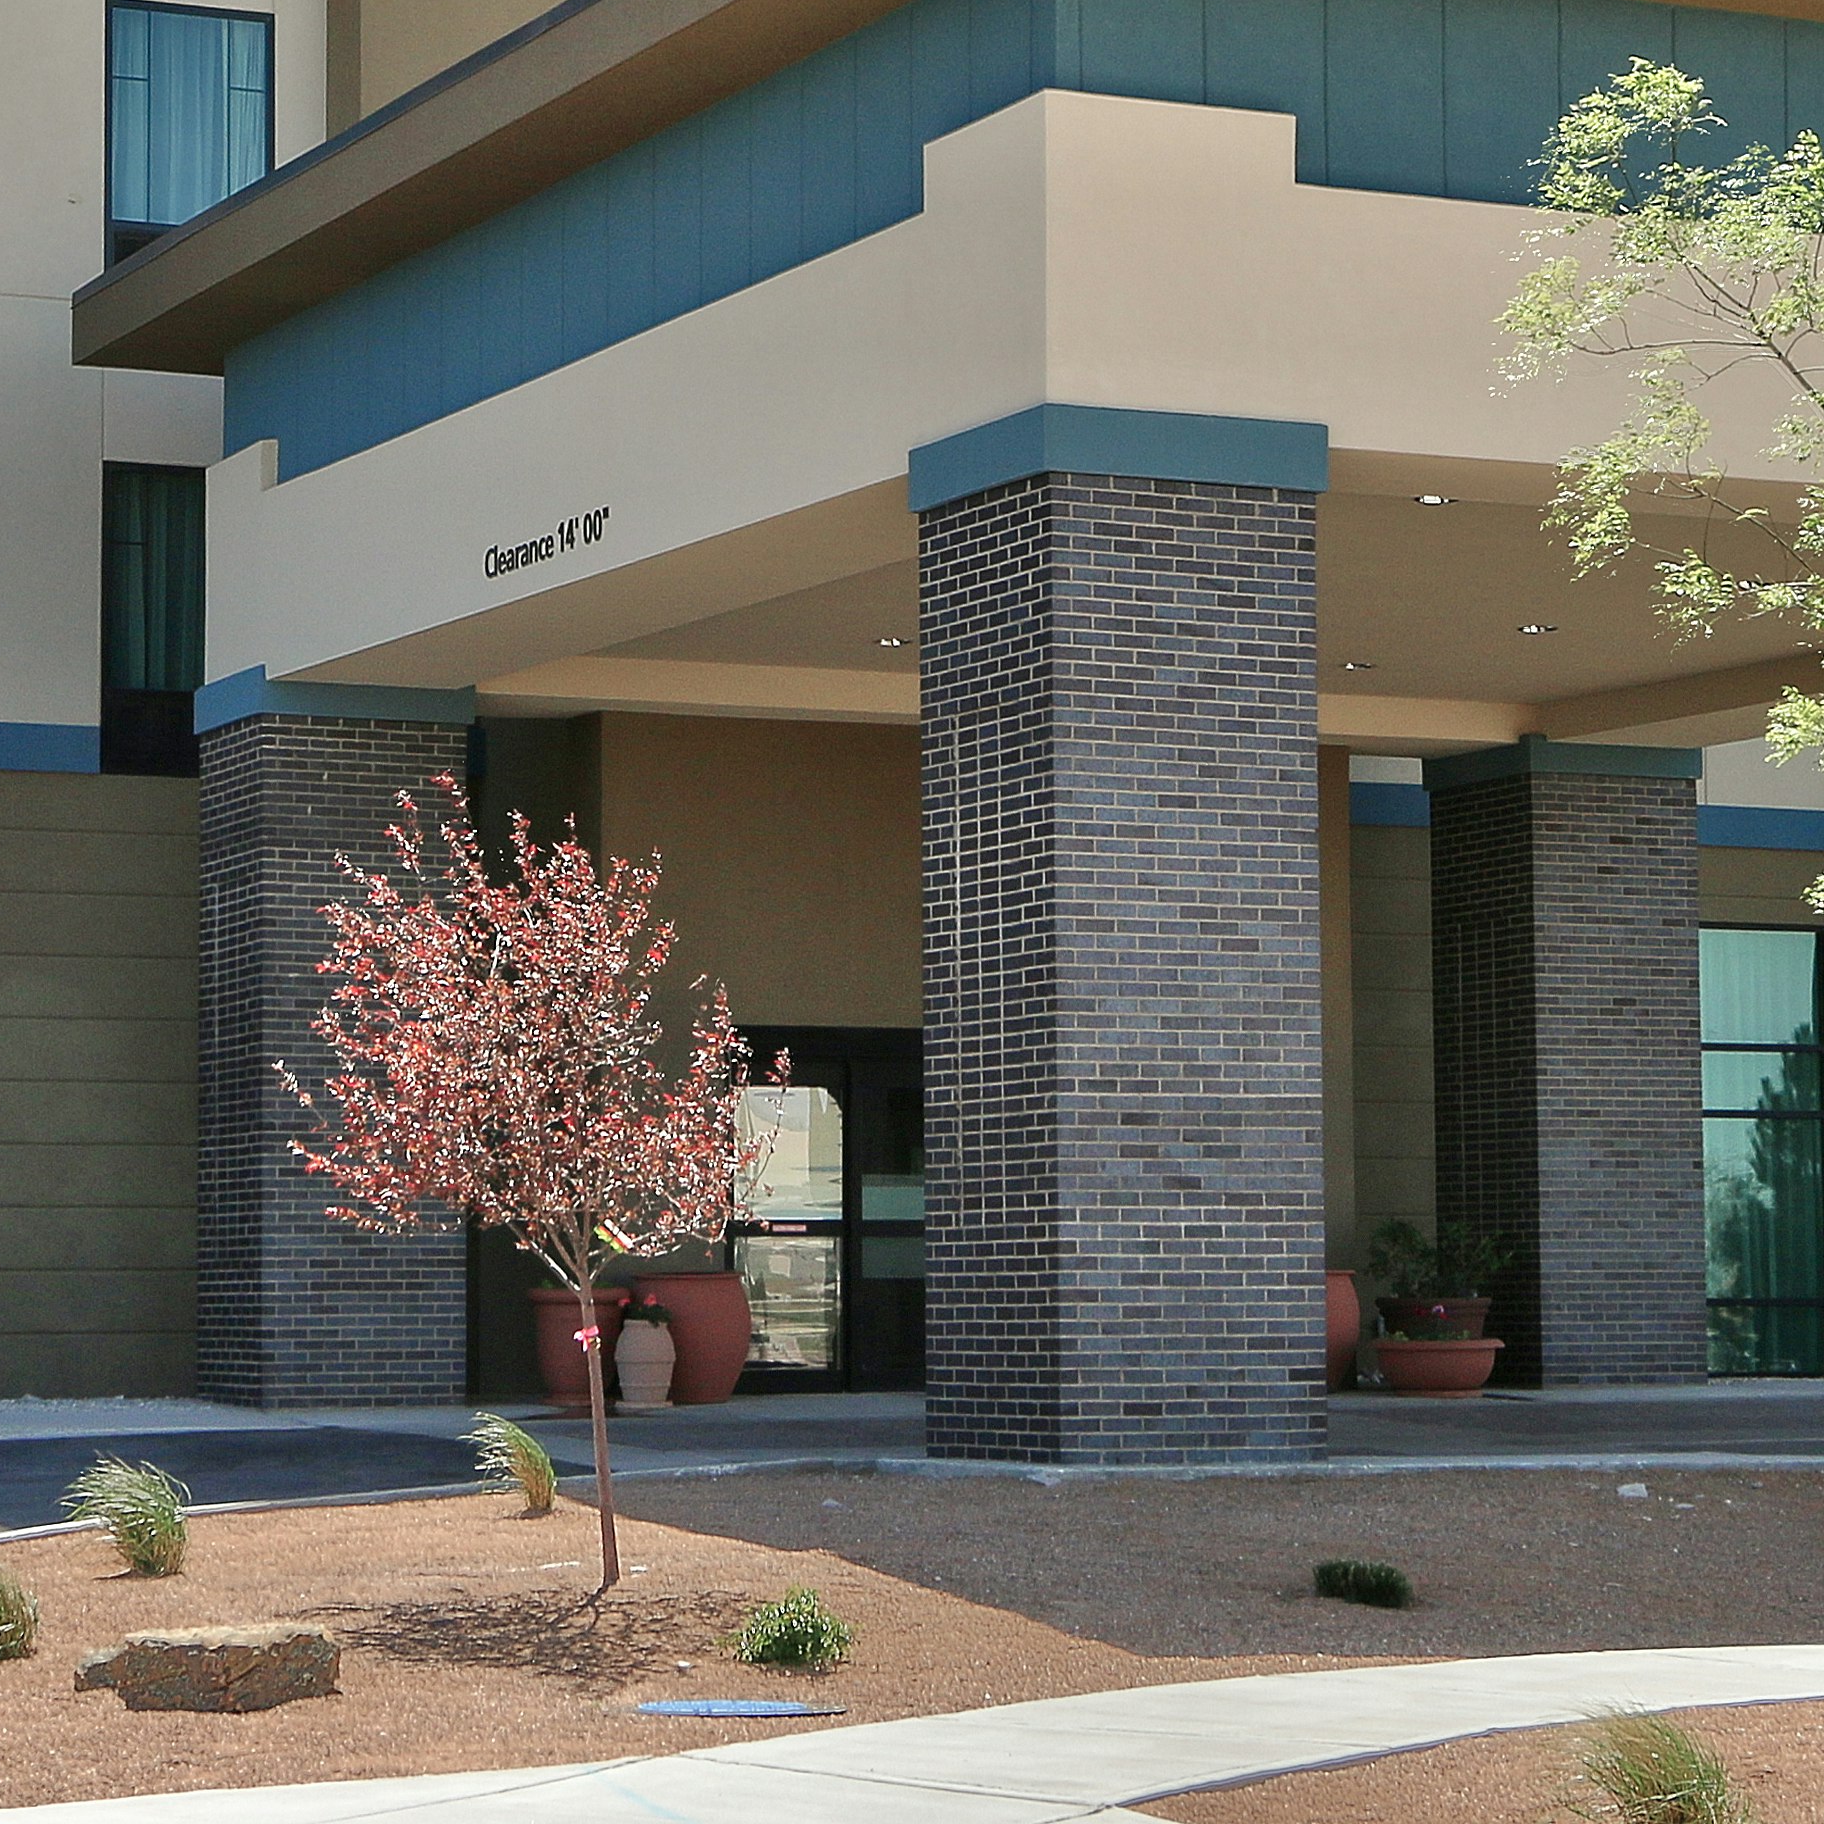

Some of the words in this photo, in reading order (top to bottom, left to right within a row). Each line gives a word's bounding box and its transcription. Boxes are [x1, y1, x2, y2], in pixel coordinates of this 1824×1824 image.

[484, 534, 555, 579] Clearance
[557, 516, 580, 553] 14'
[582, 505, 610, 545] 00"
